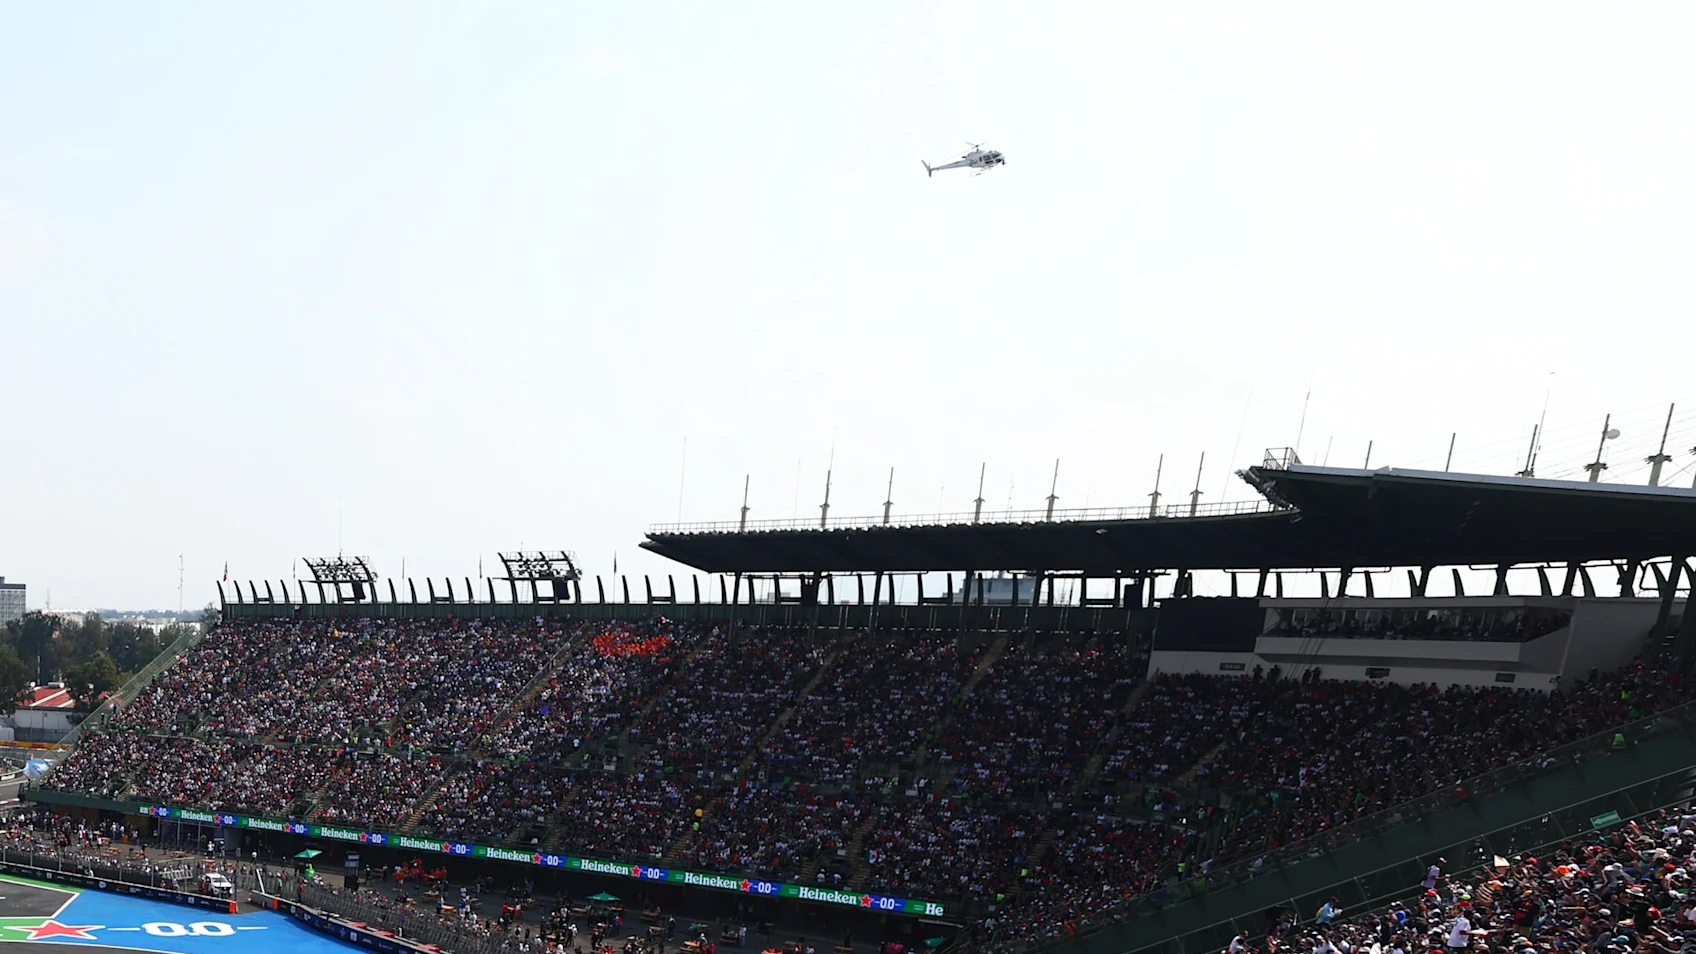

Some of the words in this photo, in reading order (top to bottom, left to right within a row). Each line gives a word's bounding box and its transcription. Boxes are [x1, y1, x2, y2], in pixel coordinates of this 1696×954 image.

[181, 810, 213, 824] Heineken
[248, 818, 283, 832] Heineken
[321, 827, 358, 841] Heineken
[400, 837, 440, 852] Heineken
[486, 848, 531, 863] Heineken
[581, 859, 629, 876] Heineken
[684, 872, 737, 890] Heineken
[799, 887, 857, 905] Heineken
[141, 921, 237, 937] 0.0
